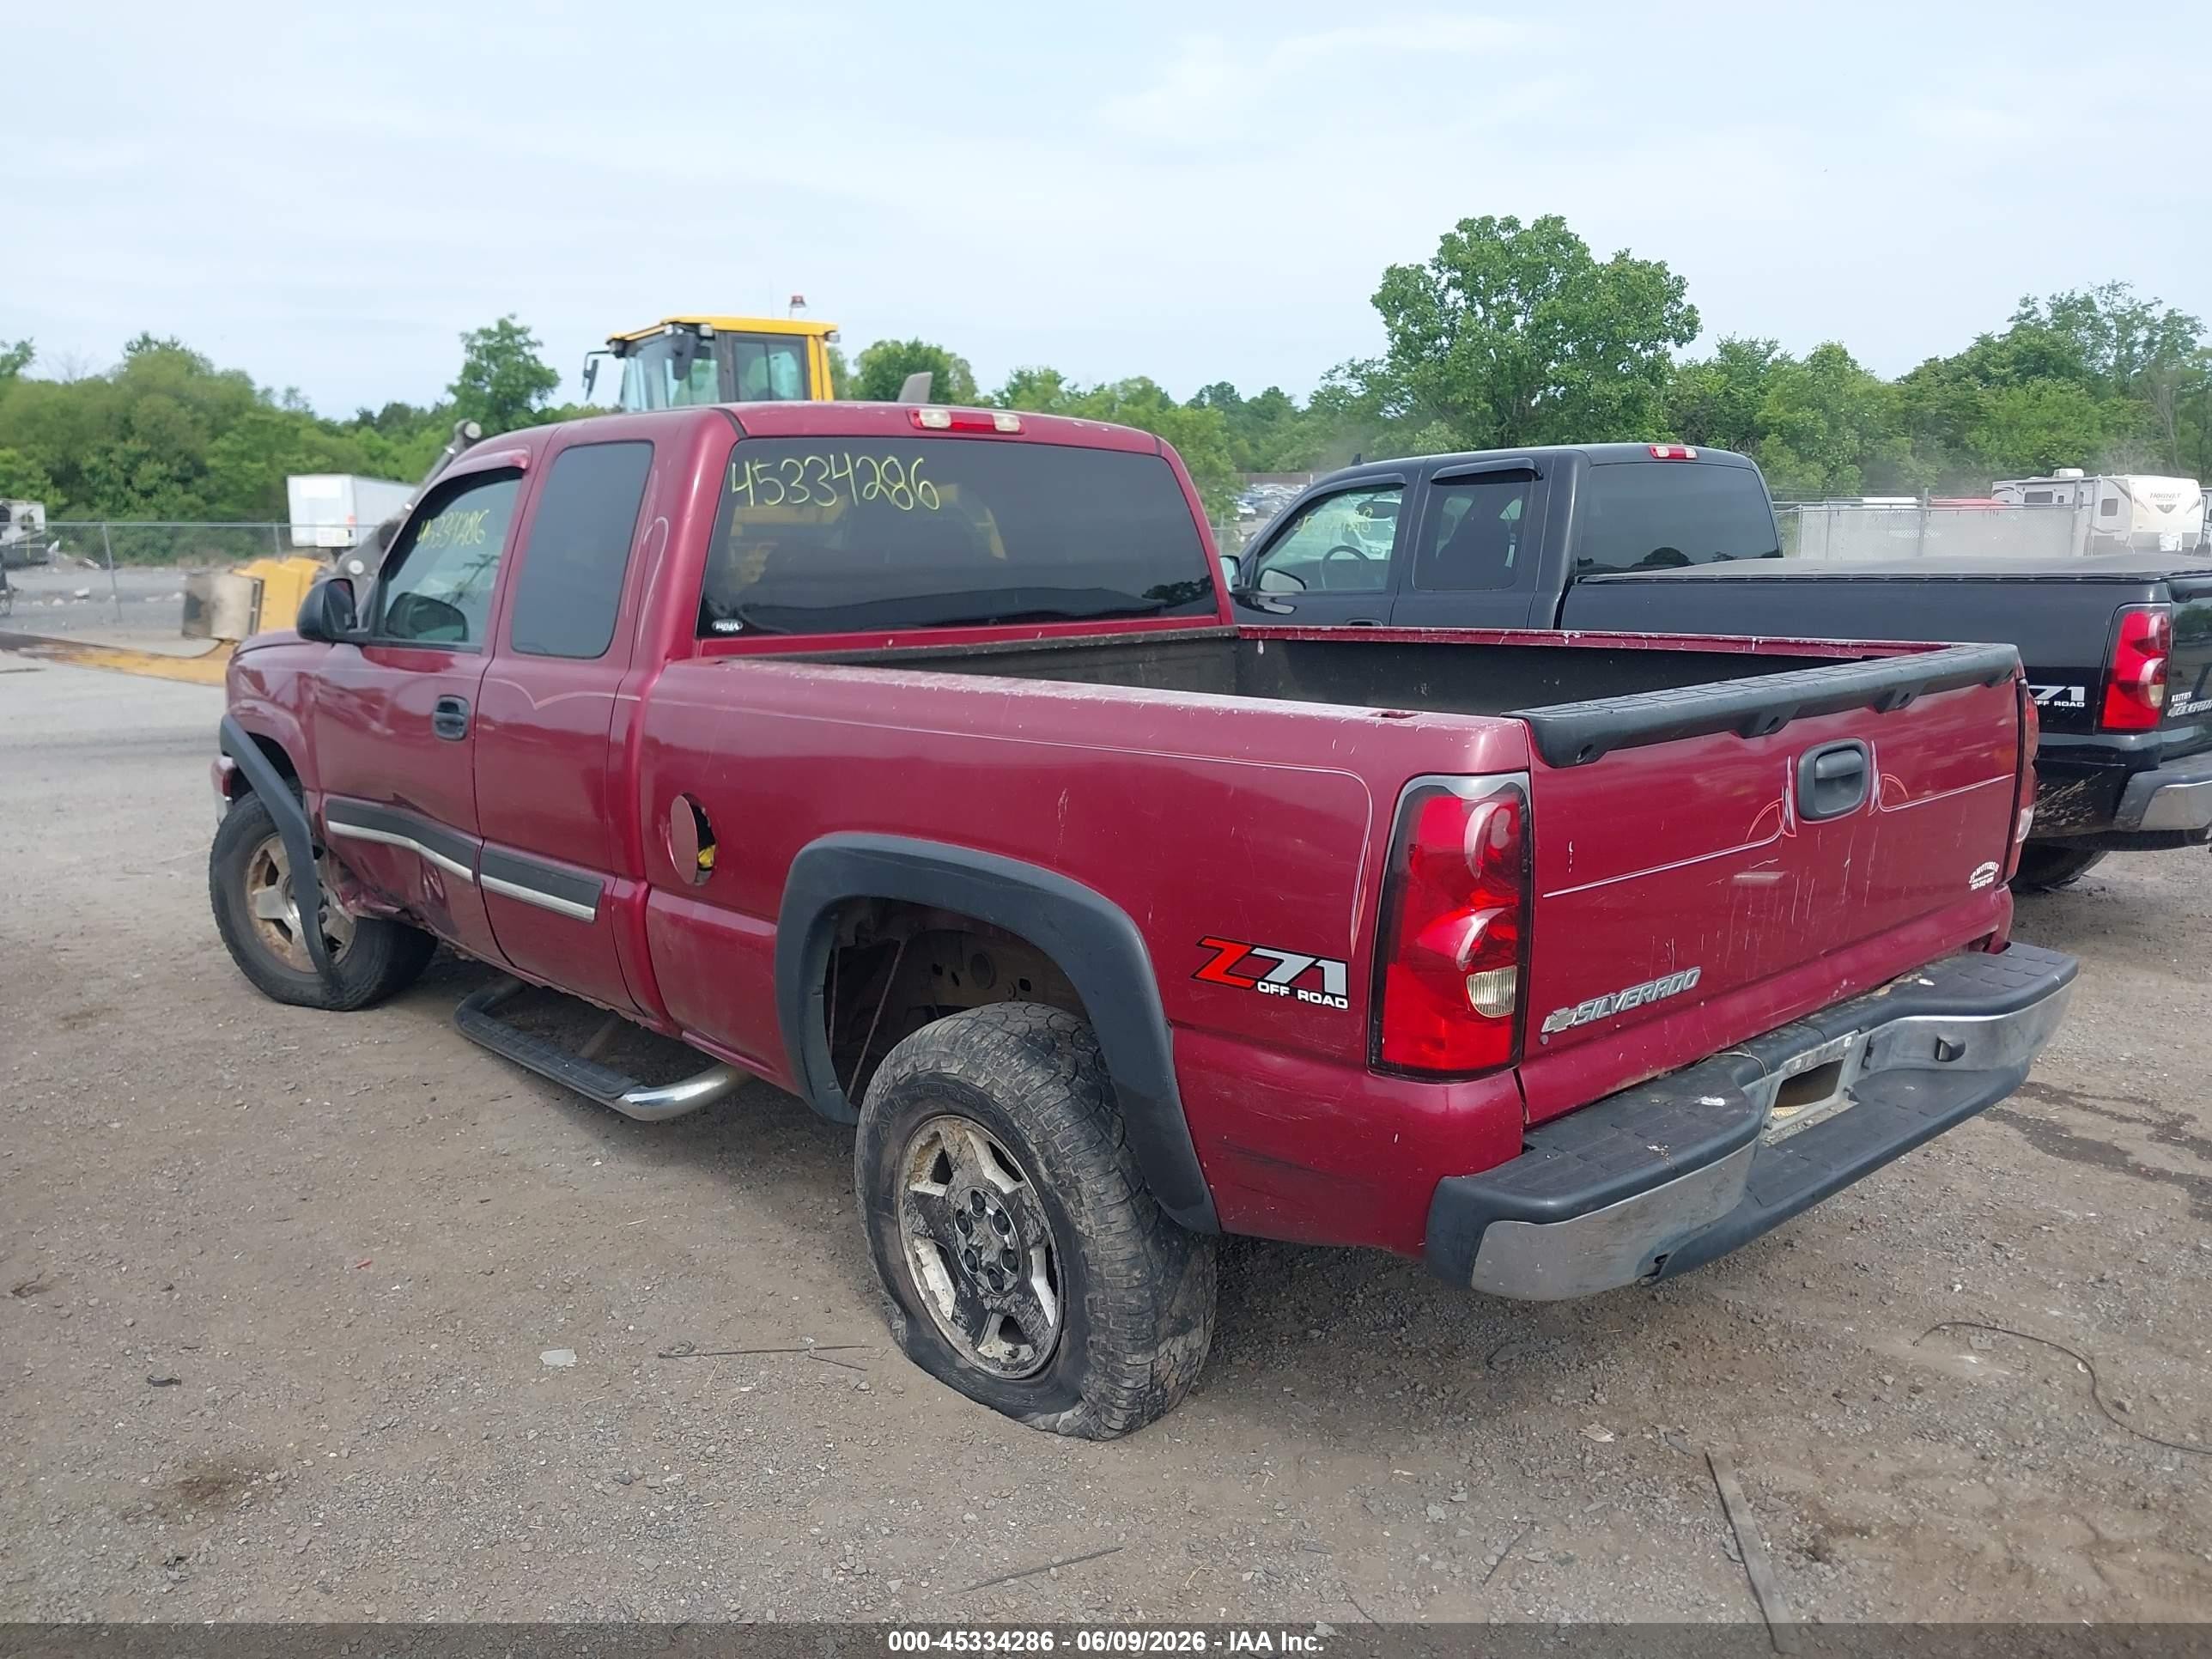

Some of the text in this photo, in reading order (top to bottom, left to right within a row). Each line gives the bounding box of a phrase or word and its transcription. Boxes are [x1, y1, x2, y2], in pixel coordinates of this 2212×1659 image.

[732, 453, 940, 511] 45334286
[1192, 936, 1348, 996] Z71
[1256, 981, 1349, 1010] OFF ROAD
[1573, 966, 1702, 1026] SILVERADO
